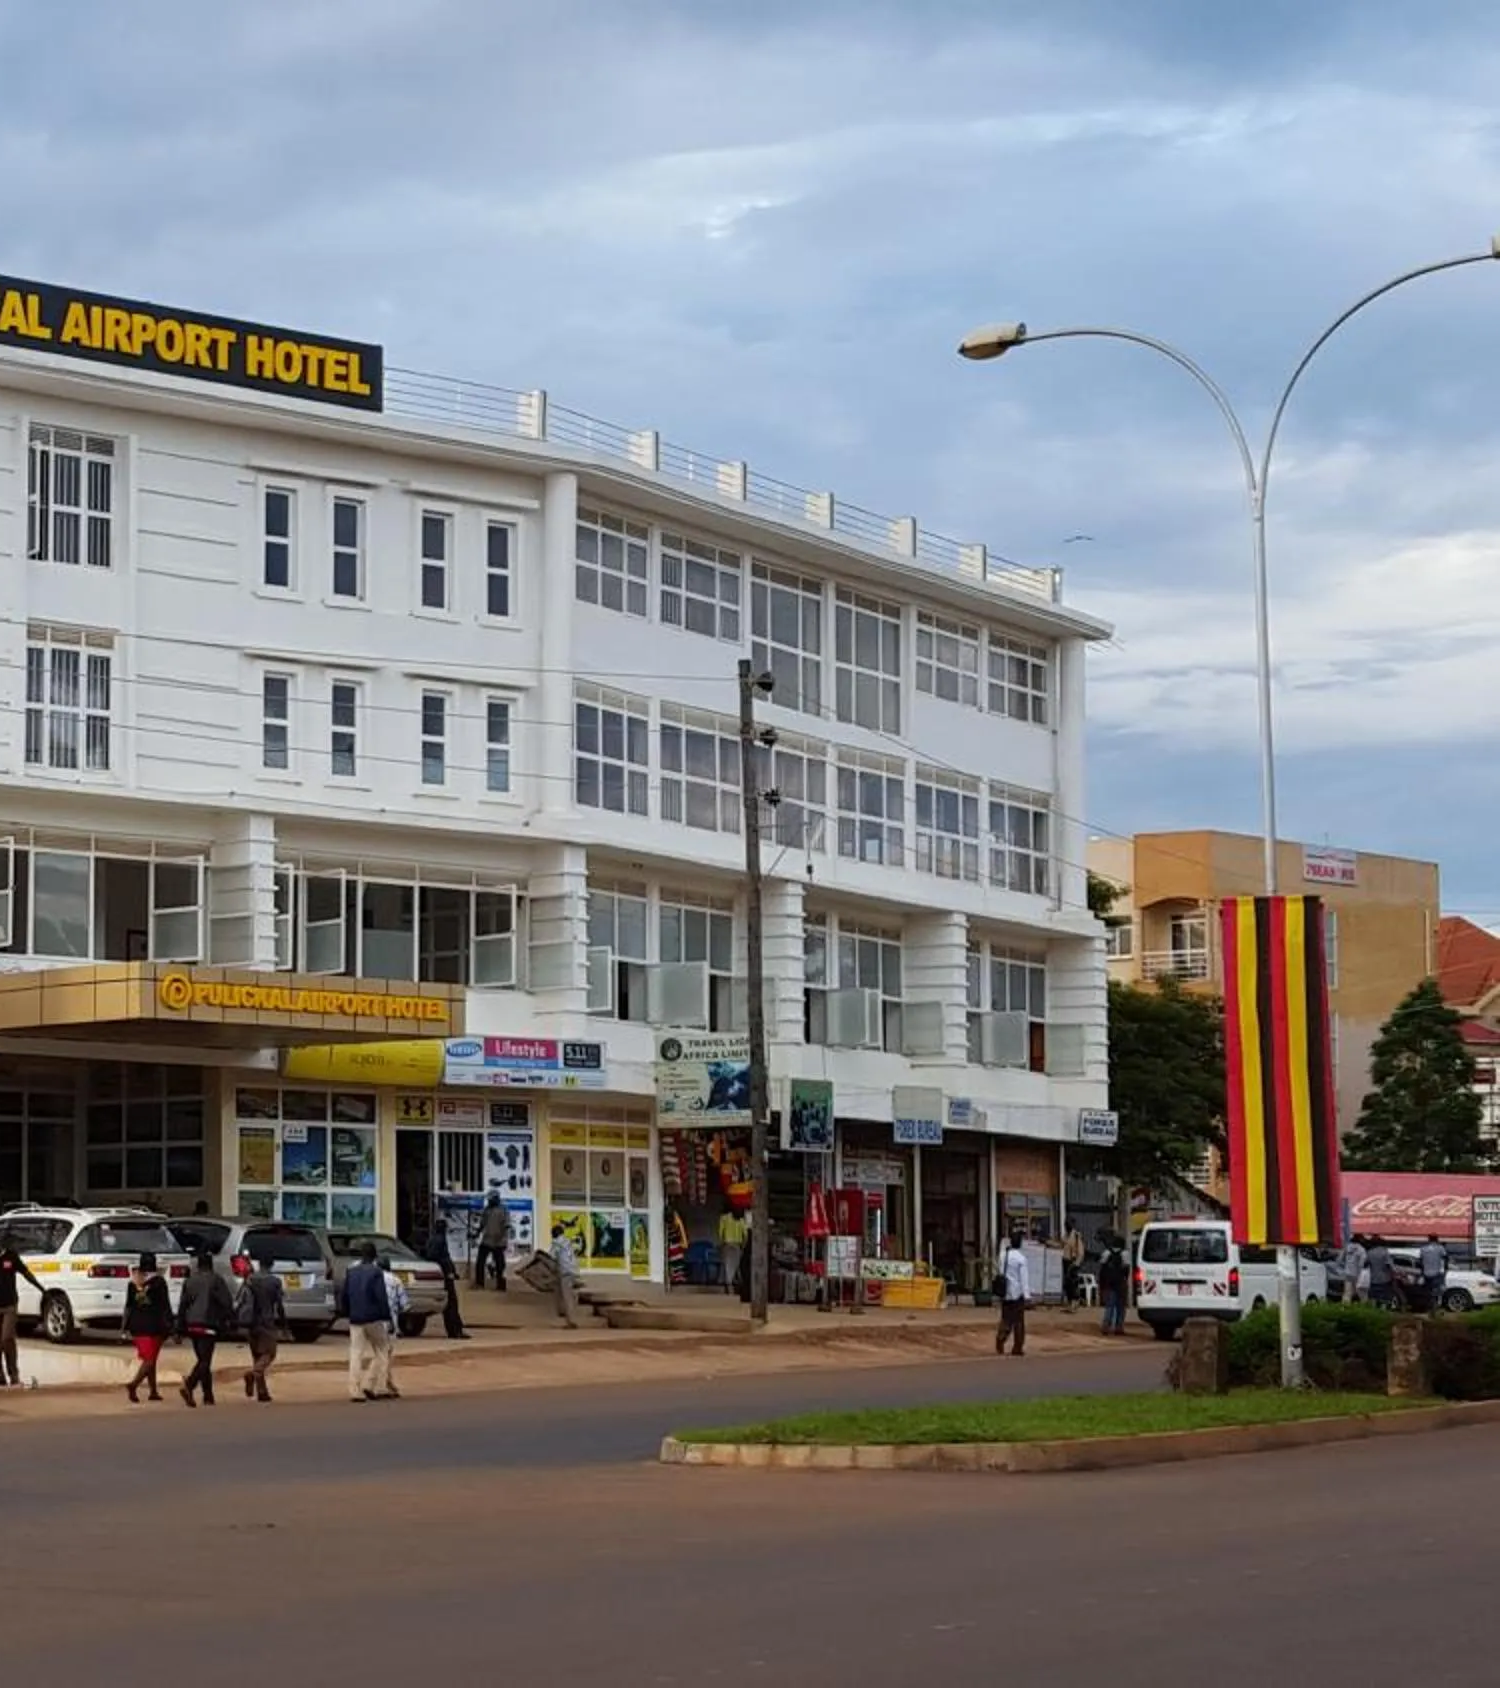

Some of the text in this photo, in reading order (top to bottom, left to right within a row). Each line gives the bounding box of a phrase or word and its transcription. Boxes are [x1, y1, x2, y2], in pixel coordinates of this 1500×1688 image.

[61, 302, 237, 371] AIRPORT
[244, 335, 371, 396] HOTEL
[193, 982, 298, 1011] PULICKAL
[299, 990, 386, 1016] AIRPORT
[390, 996, 449, 1022] HOTEL
[495, 1039, 547, 1059] Lifestyle
[688, 1038, 726, 1048] TRAVEL
[683, 1050, 719, 1060] AFRICA
